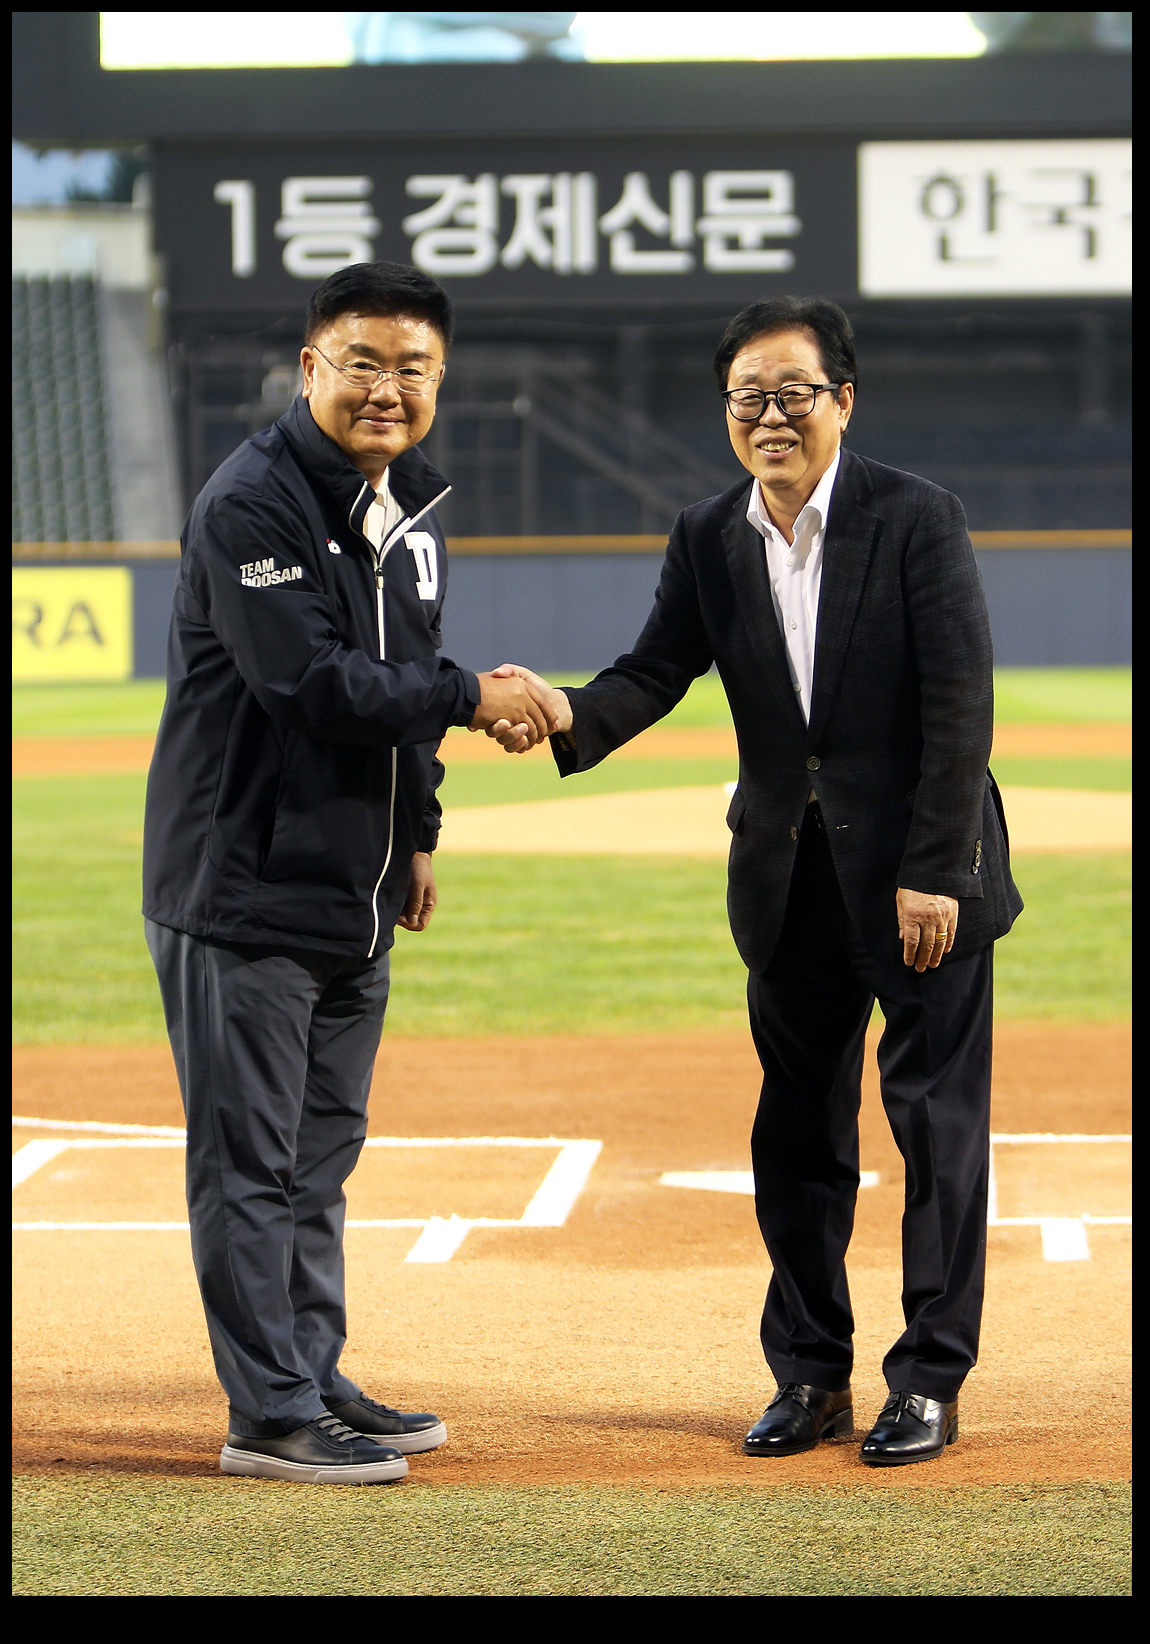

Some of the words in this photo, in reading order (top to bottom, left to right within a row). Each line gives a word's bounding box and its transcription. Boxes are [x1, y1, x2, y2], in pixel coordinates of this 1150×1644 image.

[213, 174, 382, 280] 1등
[402, 170, 802, 278] 경제신문
[911, 168, 1132, 265] 한국
[239, 557, 274, 579] TEAM
[403, 531, 438, 601] D
